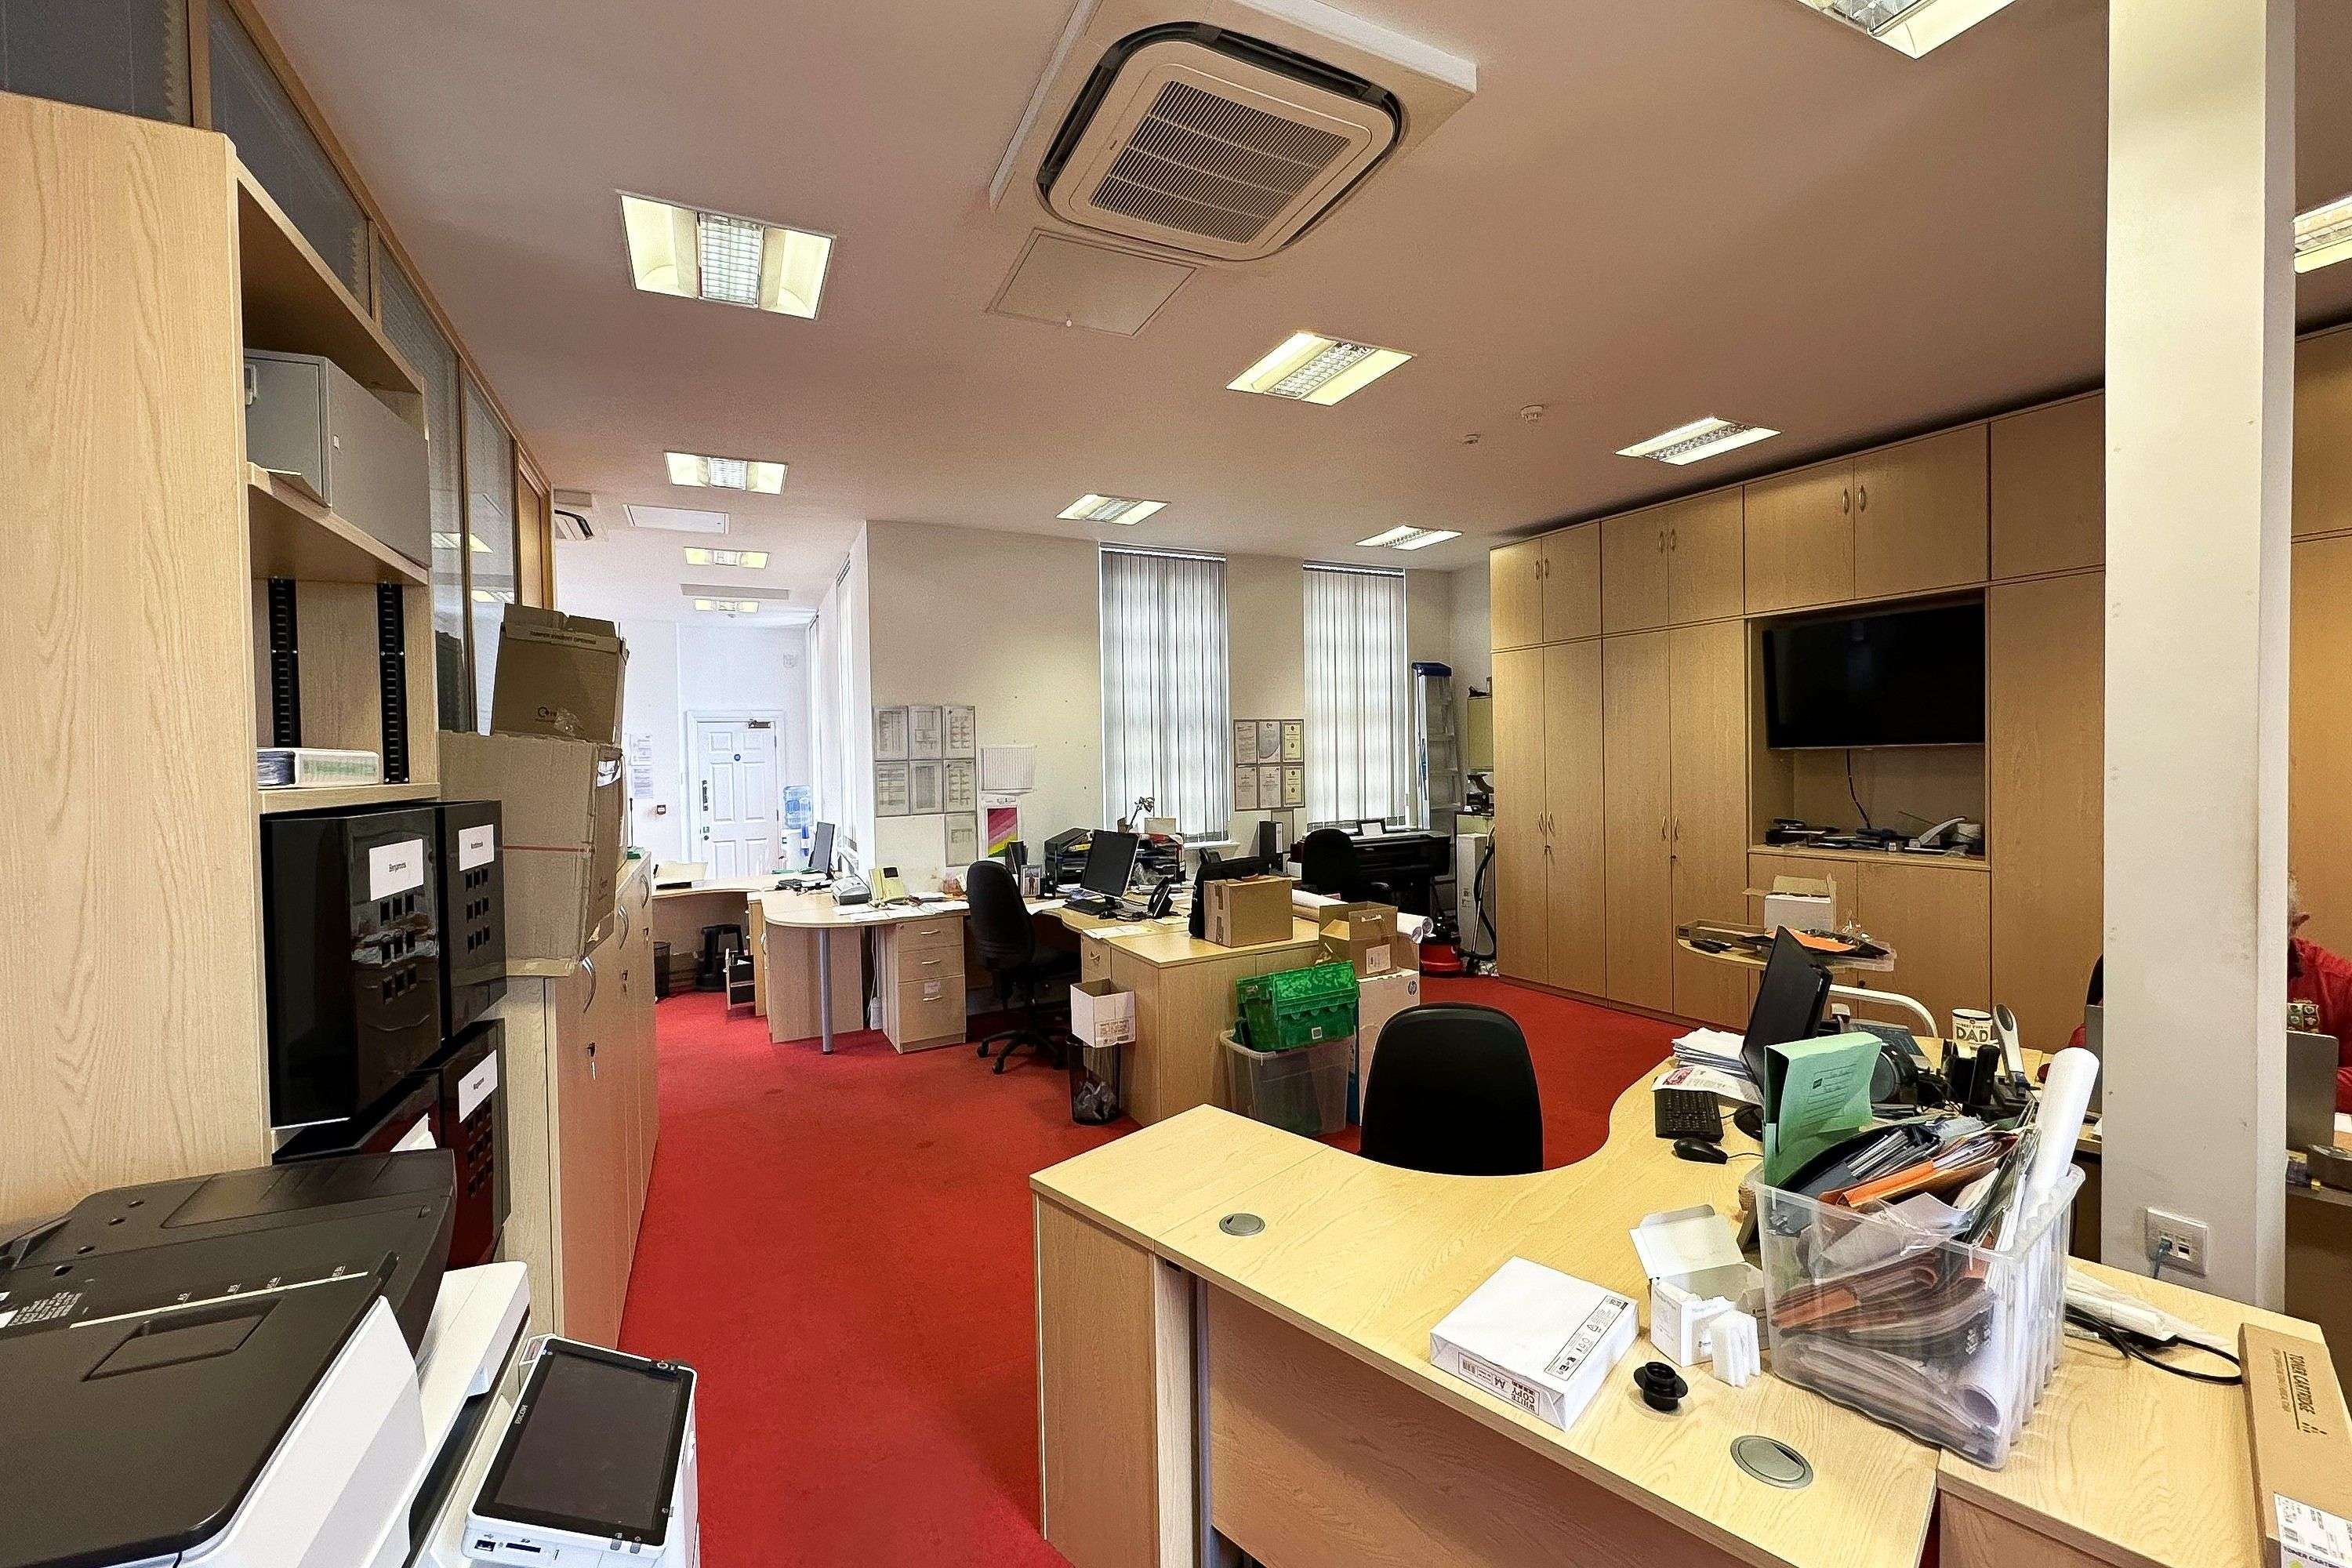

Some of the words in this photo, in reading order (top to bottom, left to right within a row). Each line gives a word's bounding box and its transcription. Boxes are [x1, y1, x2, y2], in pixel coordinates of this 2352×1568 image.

[1956, 1025, 1988, 1042] DAD
[2289, 1354, 2307, 1376] TONER
[1494, 1374, 1506, 1389] A4
[1512, 1388, 1535, 1403] COPY
[2293, 1375, 2315, 1414] CARTRIDGE
[1512, 1395, 1535, 1411] WHITE
[514, 1405, 528, 1424] RICOH
[2283, 1546, 2307, 1559] TONER
